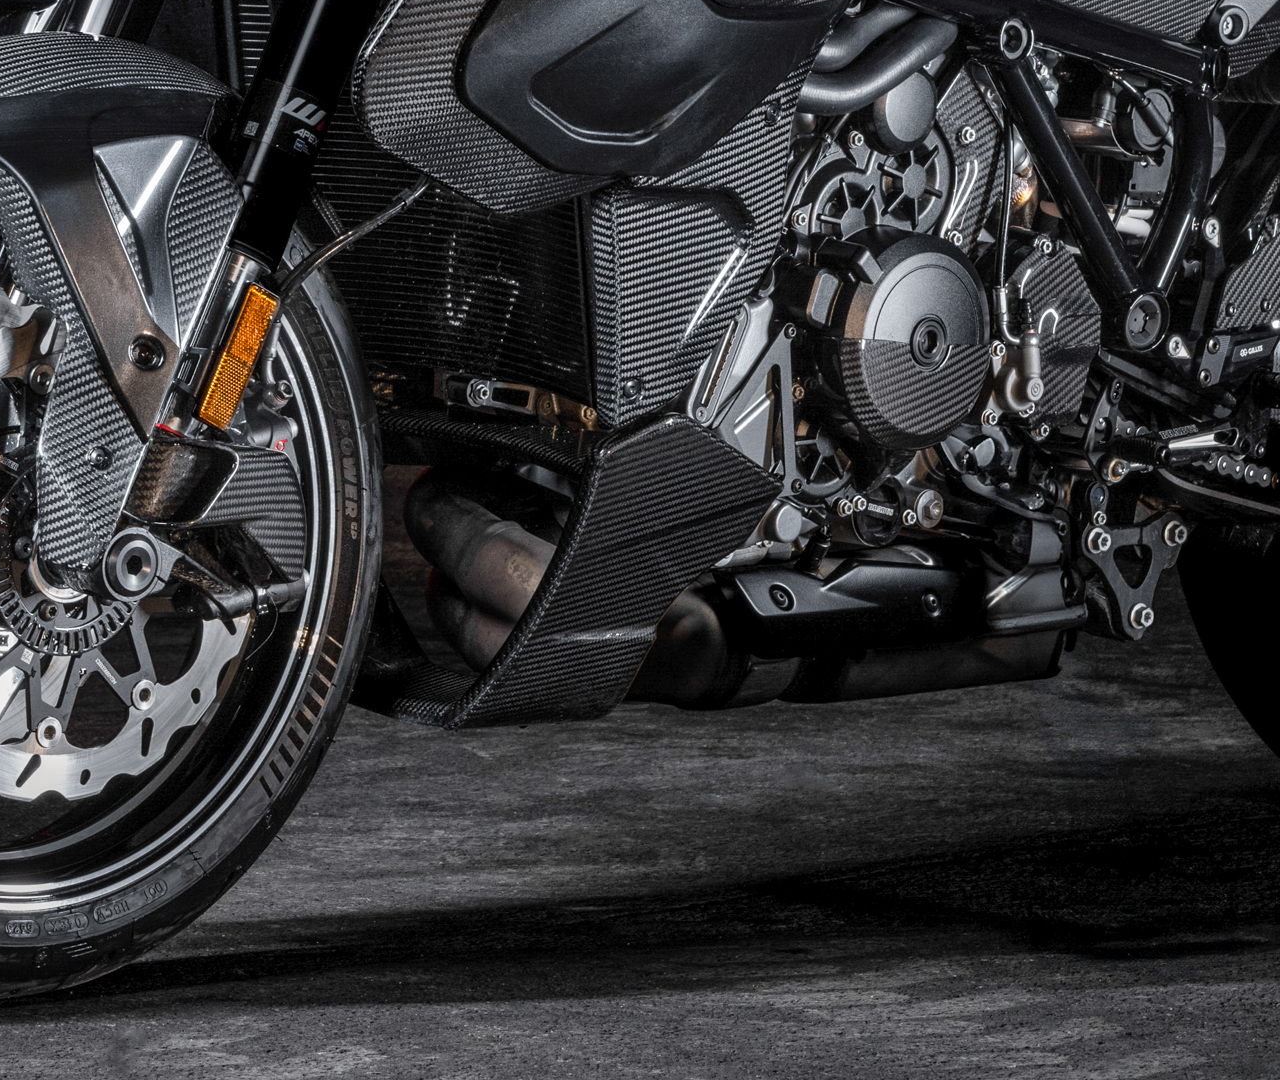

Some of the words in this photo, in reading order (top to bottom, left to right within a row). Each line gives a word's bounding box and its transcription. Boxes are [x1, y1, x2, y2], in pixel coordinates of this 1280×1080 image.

[293, 128, 320, 147] APEX
[1158, 423, 1199, 440] BRABUS
[336, 419, 358, 518] POWER
